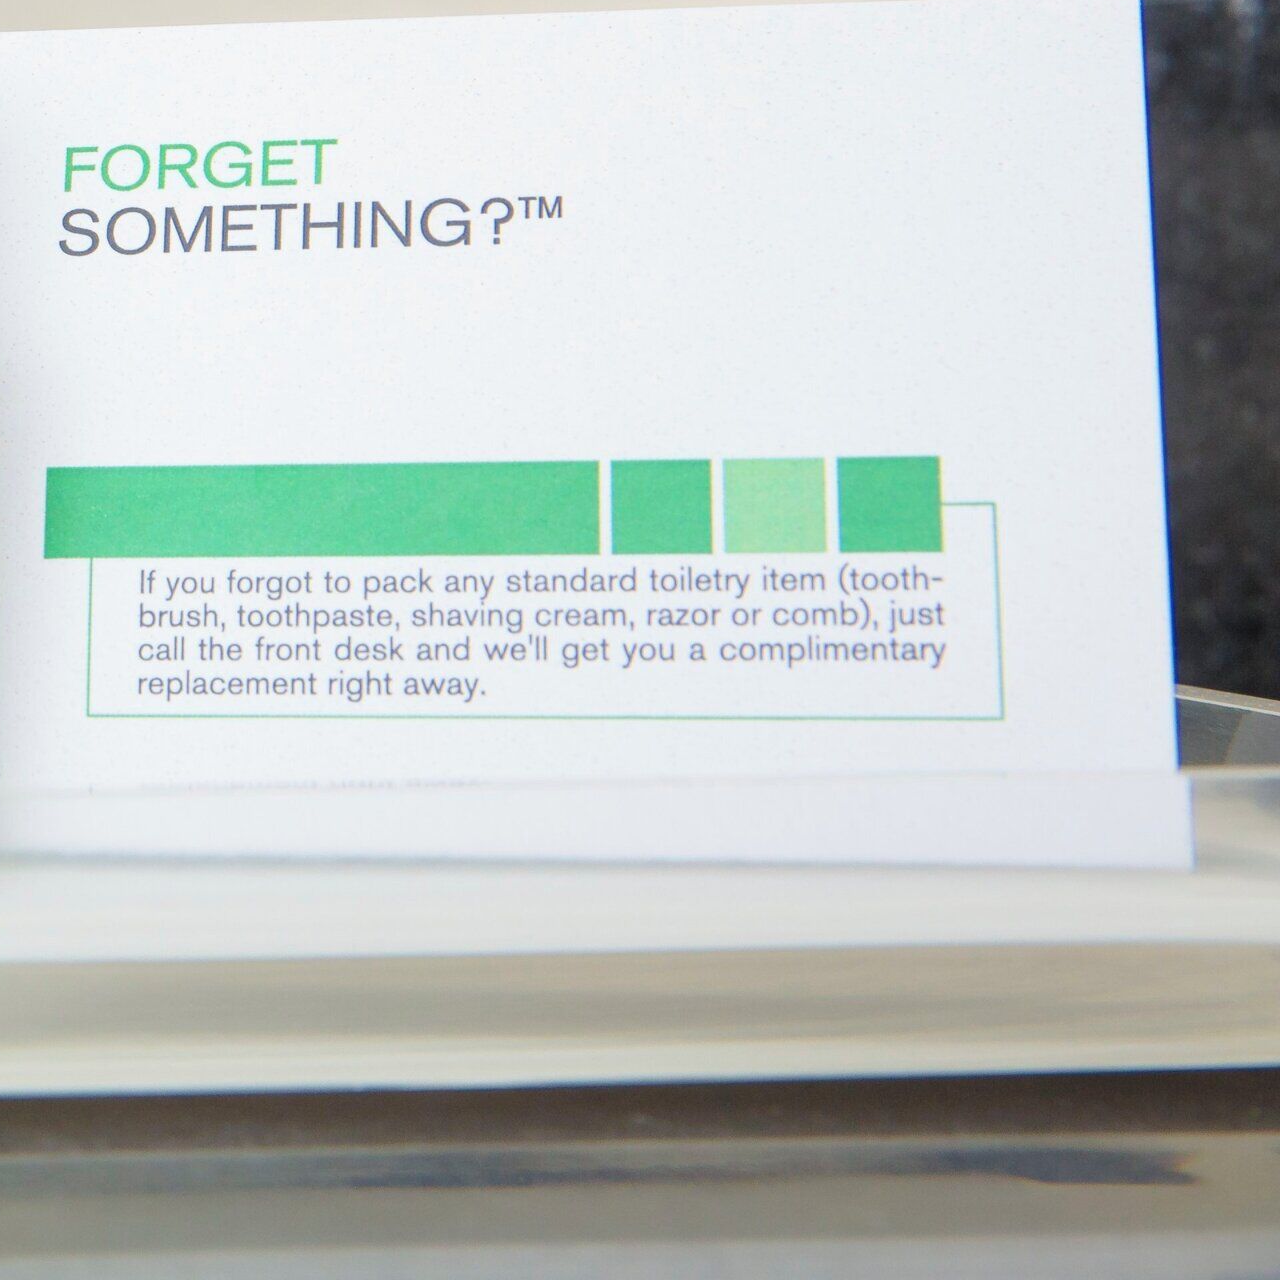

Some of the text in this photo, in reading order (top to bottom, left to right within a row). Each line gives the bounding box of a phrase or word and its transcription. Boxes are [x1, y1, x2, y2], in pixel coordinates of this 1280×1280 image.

[63, 138, 338, 193] FORGET
[140, 563, 942, 602] If you forgot to pack any standard toiletry item (tooth-
[139, 596, 944, 635] brush, toothpaste, shaving cream, razor or comb), just
[138, 633, 946, 670] call the front desk and we'll get you a complimentary
[138, 669, 486, 703] replacement right away.
